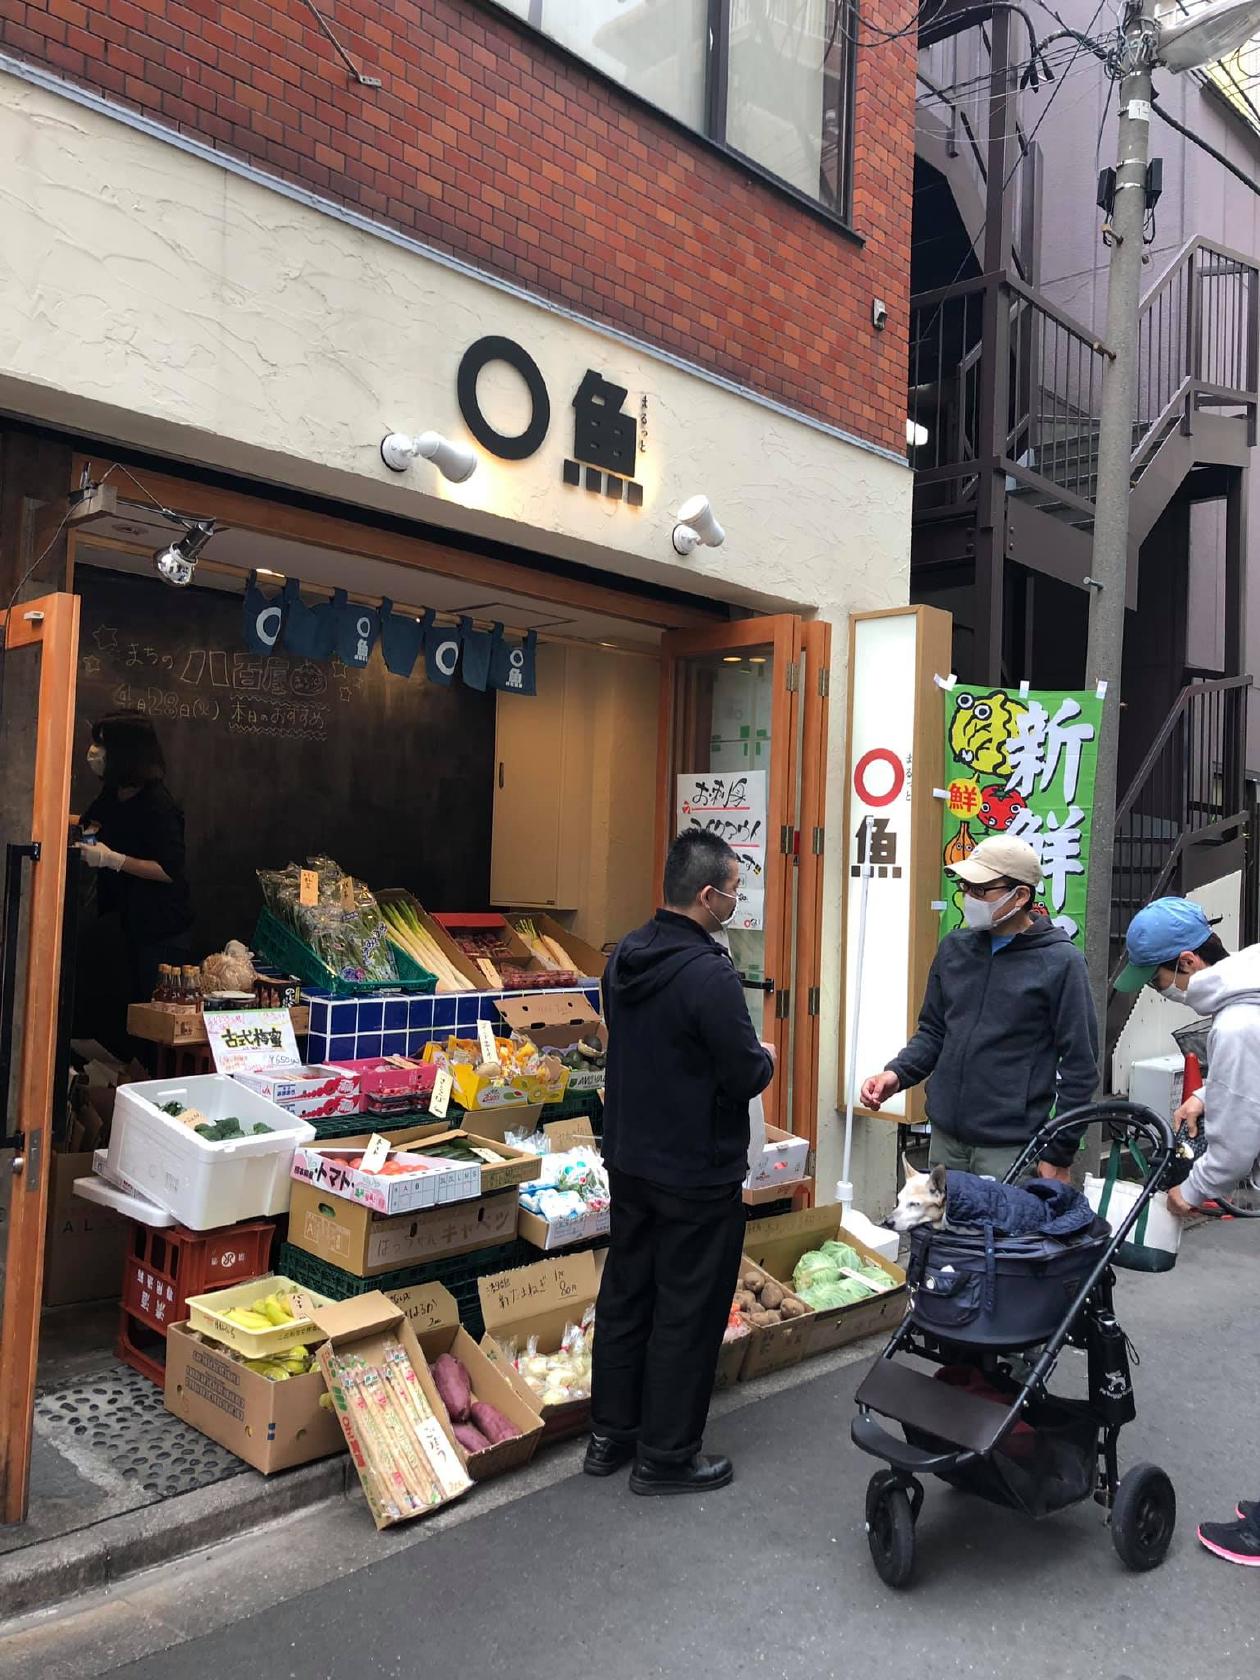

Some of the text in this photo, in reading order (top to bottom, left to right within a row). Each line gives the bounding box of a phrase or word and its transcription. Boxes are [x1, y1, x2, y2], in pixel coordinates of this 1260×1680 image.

[638, 394, 649, 454] まるっと
[231, 700, 325, 729] 本日のおすすめ
[692, 777, 748, 808] お刺身
[904, 752, 914, 803] まるっと
[949, 783, 979, 814] 鮮
[221, 1027, 283, 1048] 古式梅蜜
